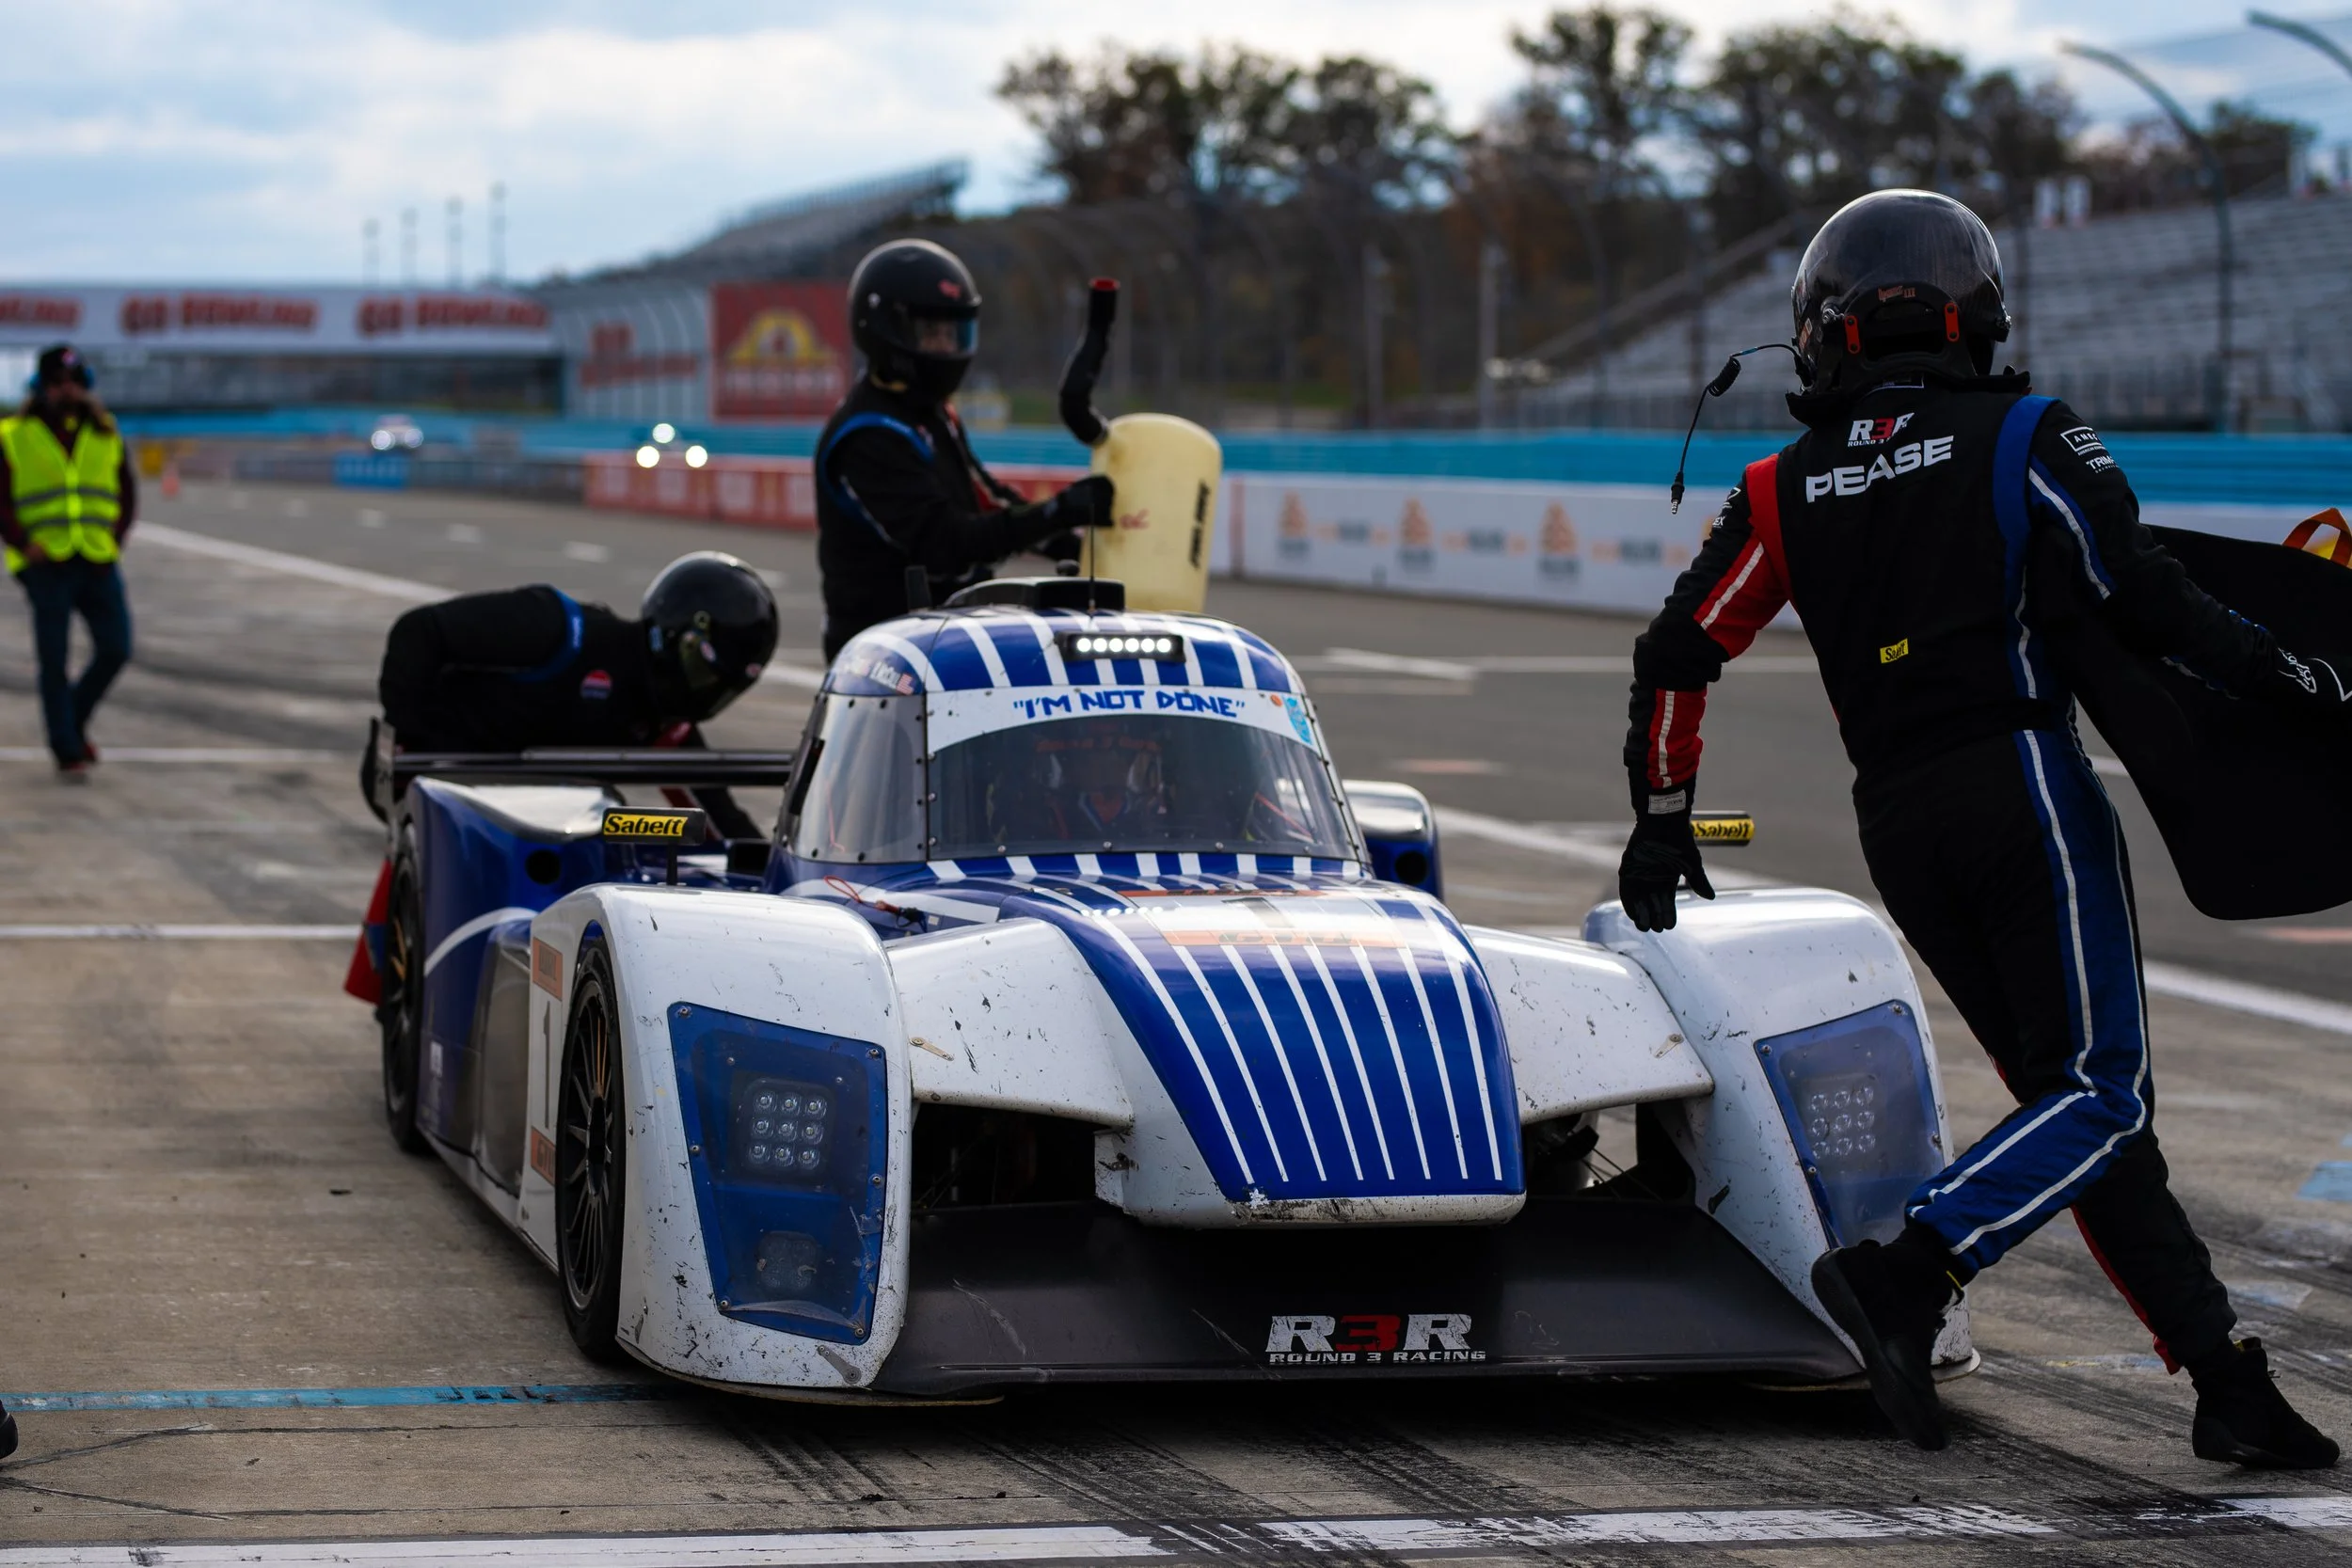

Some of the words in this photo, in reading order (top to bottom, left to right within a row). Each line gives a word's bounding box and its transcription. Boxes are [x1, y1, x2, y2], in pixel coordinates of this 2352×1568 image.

[1805, 435, 1954, 503] PEASE
[1081, 690, 1145, 710] NOT
[605, 816, 682, 835] Sabelt
[1265, 1313, 1471, 1352] R3R
[1269, 1352, 1357, 1363] ROUND
[1367, 1352, 1381, 1361] 3
[1393, 1350, 1486, 1362] RACING
